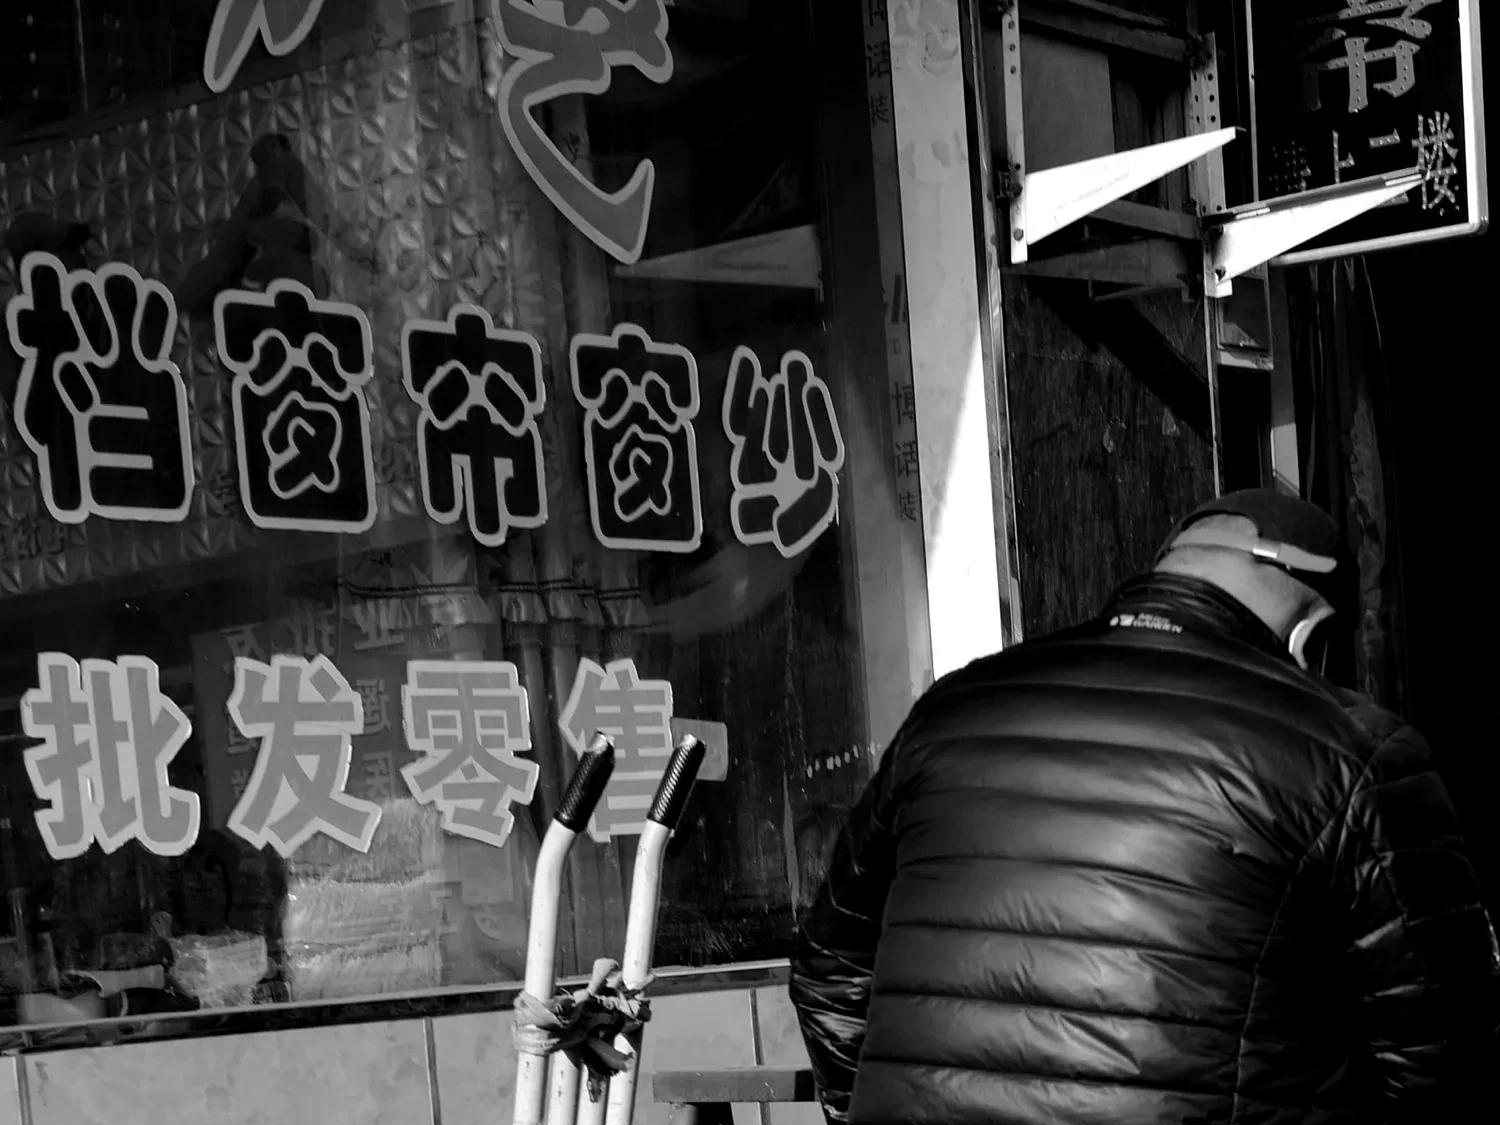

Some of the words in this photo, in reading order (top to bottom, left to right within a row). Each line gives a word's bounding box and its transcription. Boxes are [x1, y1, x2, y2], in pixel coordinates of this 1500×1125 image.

[7, 251, 845, 558] 档窗帘窗纱
[21, 652, 673, 859] 批发零售
